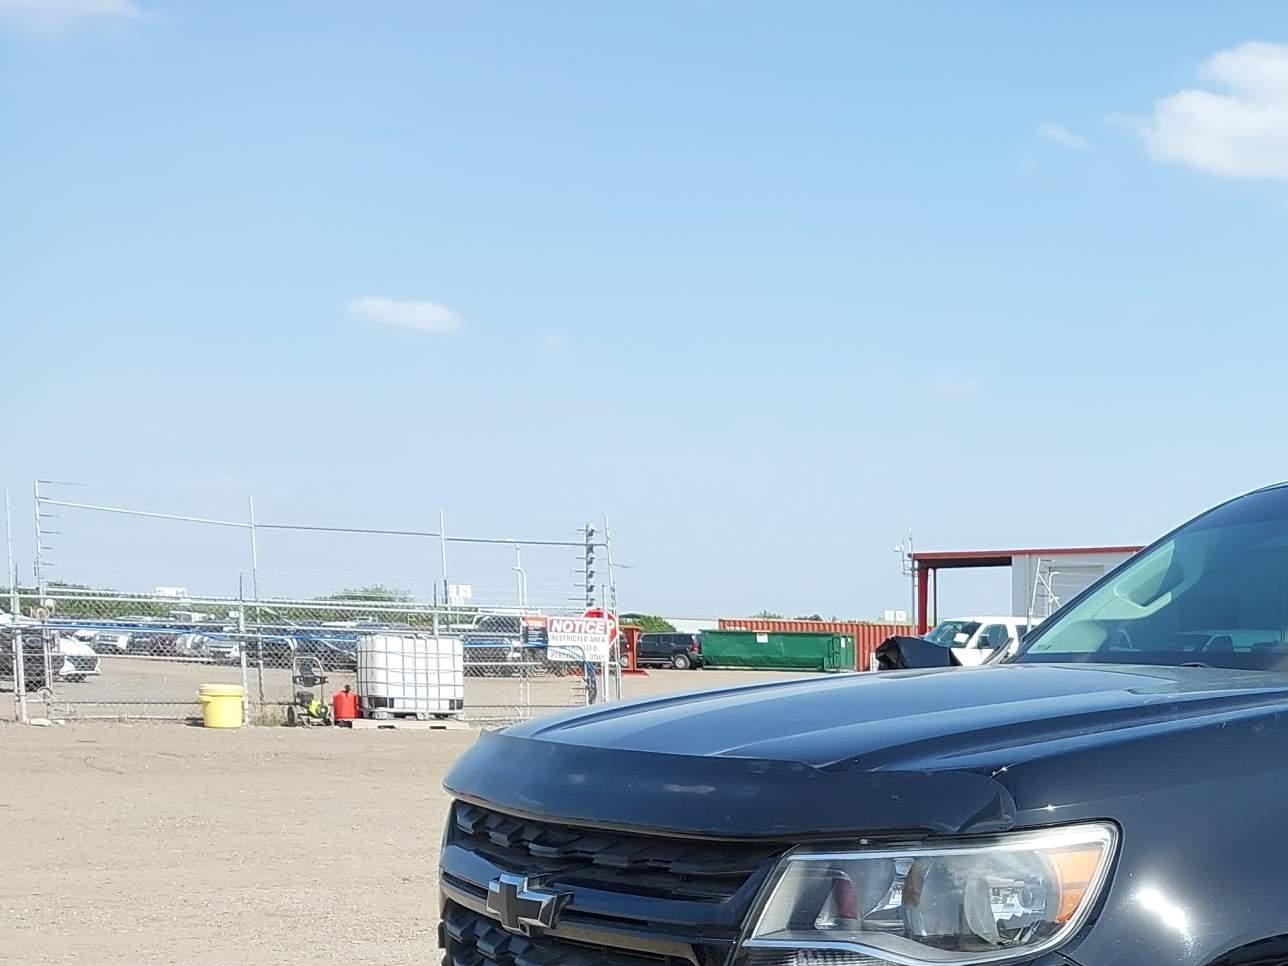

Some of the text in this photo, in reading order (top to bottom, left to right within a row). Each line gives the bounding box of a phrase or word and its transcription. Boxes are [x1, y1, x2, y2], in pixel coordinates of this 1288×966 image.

[550, 620, 604, 634] NOTICE
[551, 634, 588, 643] RESTRICTED
[590, 635, 606, 643] AREA
